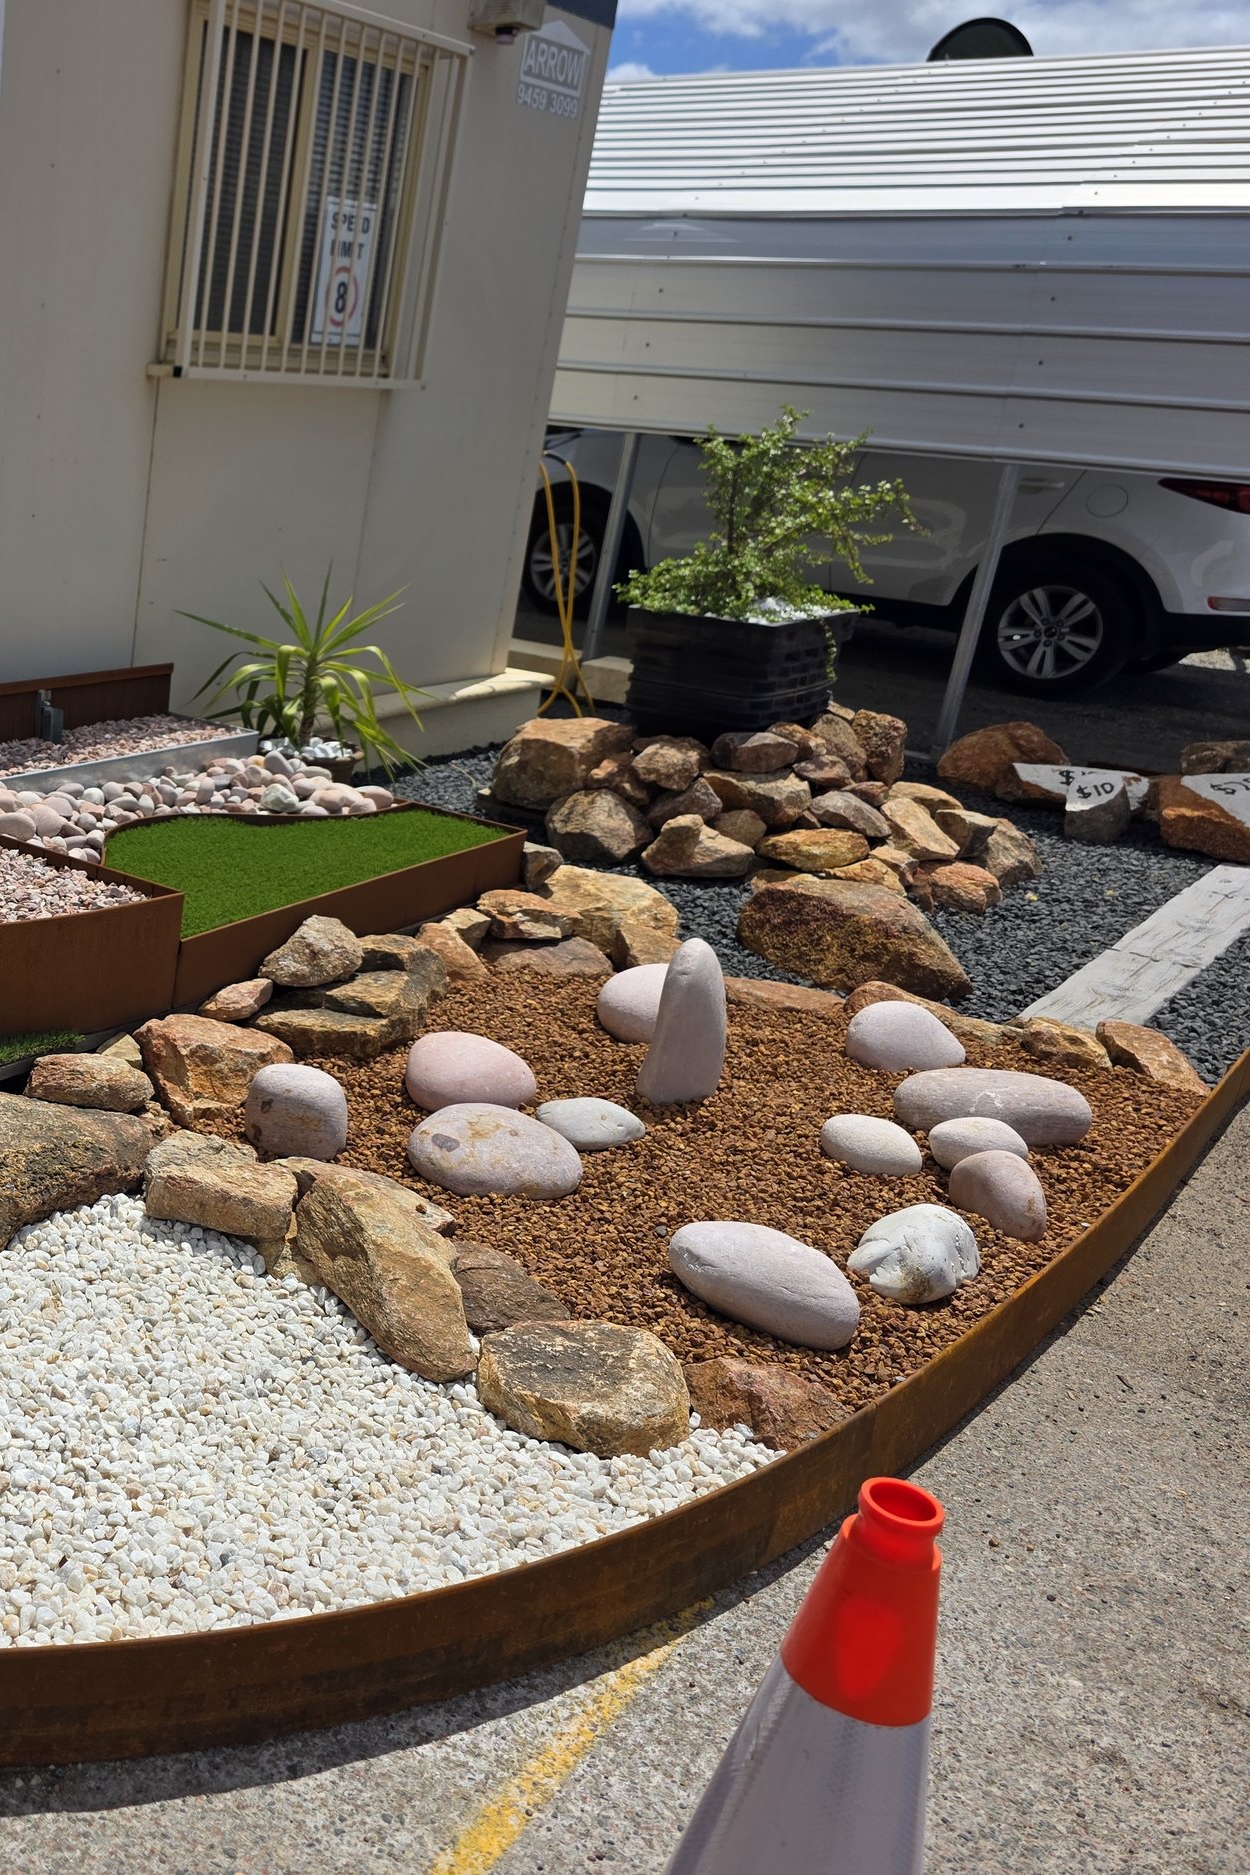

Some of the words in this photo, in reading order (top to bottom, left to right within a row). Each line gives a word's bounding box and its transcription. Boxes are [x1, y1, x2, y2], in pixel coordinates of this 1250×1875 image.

[524, 39, 582, 86] ARROW
[517, 84, 547, 110] 9459
[549, 94, 579, 119] 3099
[330, 211, 370, 232] SED
[334, 281, 348, 315] 8
[1076, 781, 1115, 799] $10
